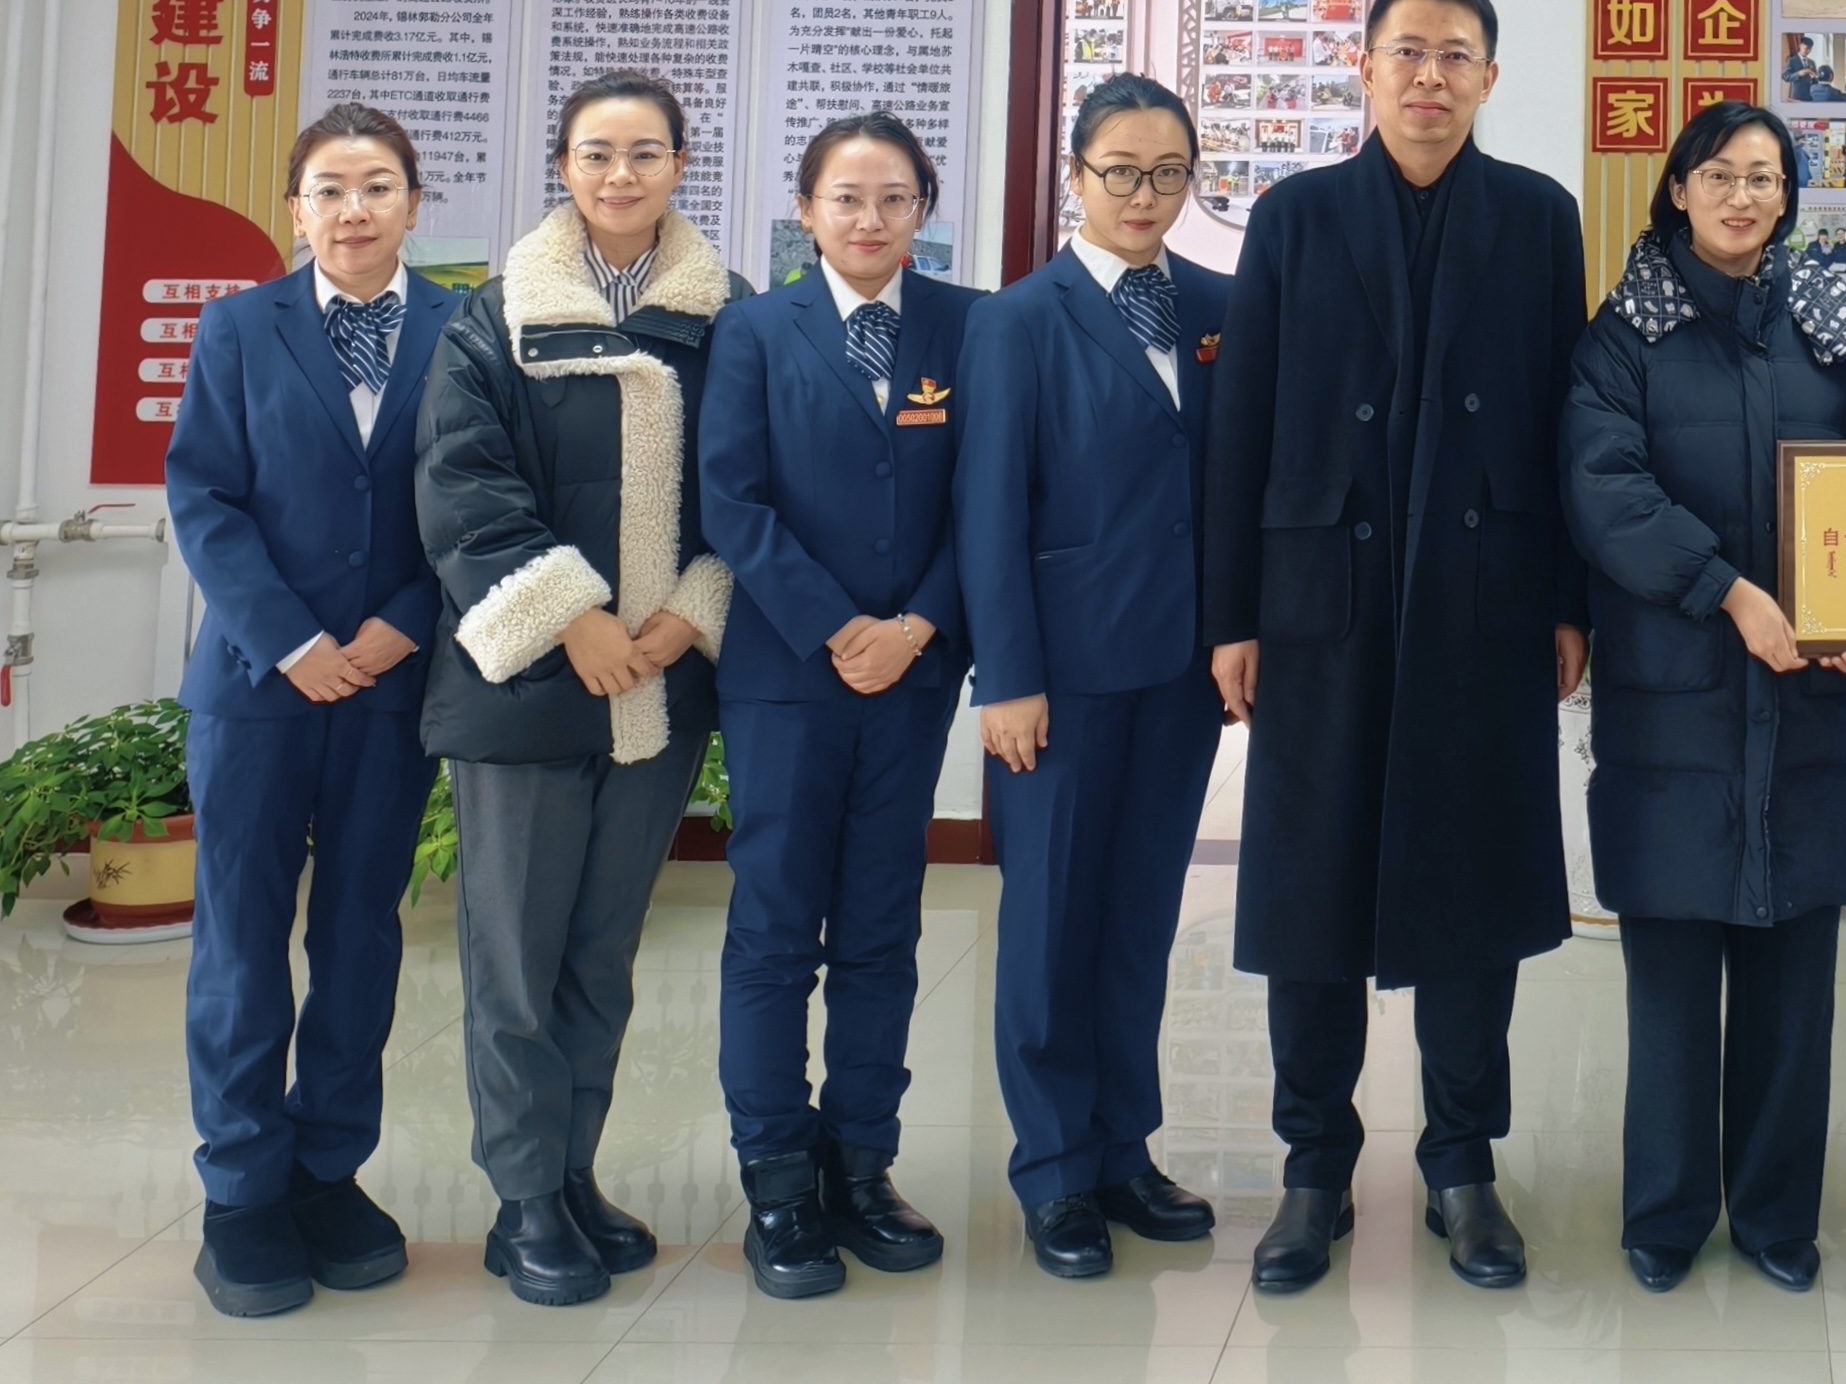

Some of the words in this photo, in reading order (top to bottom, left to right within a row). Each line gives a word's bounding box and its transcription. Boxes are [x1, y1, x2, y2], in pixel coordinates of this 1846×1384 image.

[406, 129, 488, 143] 通行费412万元。
[417, 150, 486, 163] 11947台，累
